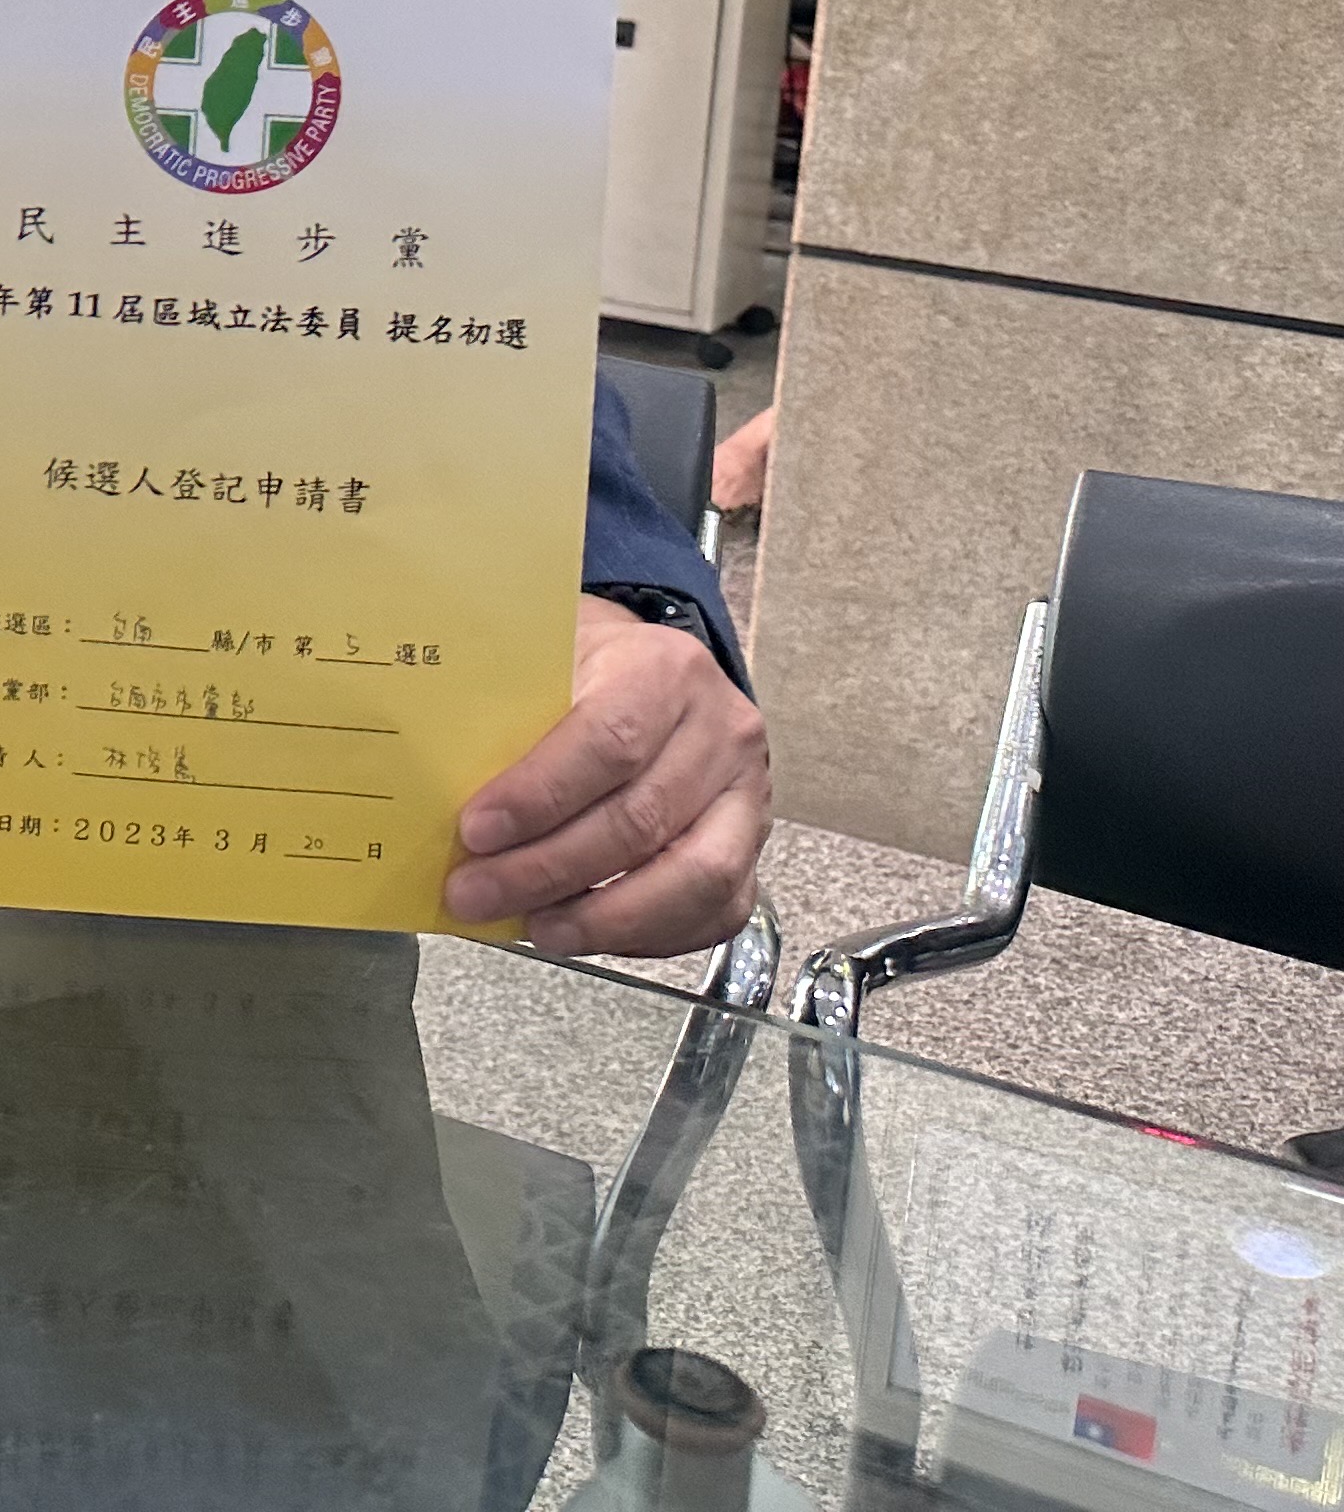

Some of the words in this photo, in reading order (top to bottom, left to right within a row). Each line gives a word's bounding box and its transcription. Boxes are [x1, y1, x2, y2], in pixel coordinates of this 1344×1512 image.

[128, 74, 189, 177] DEMOCRATIC
[192, 139, 315, 190] PROGRESSIVE
[304, 84, 337, 143] PARTY
[16, 206, 430, 269] 民主進步黨
[385, 311, 529, 350] 提名初選
[42, 456, 372, 516] 候選人登記申請書
